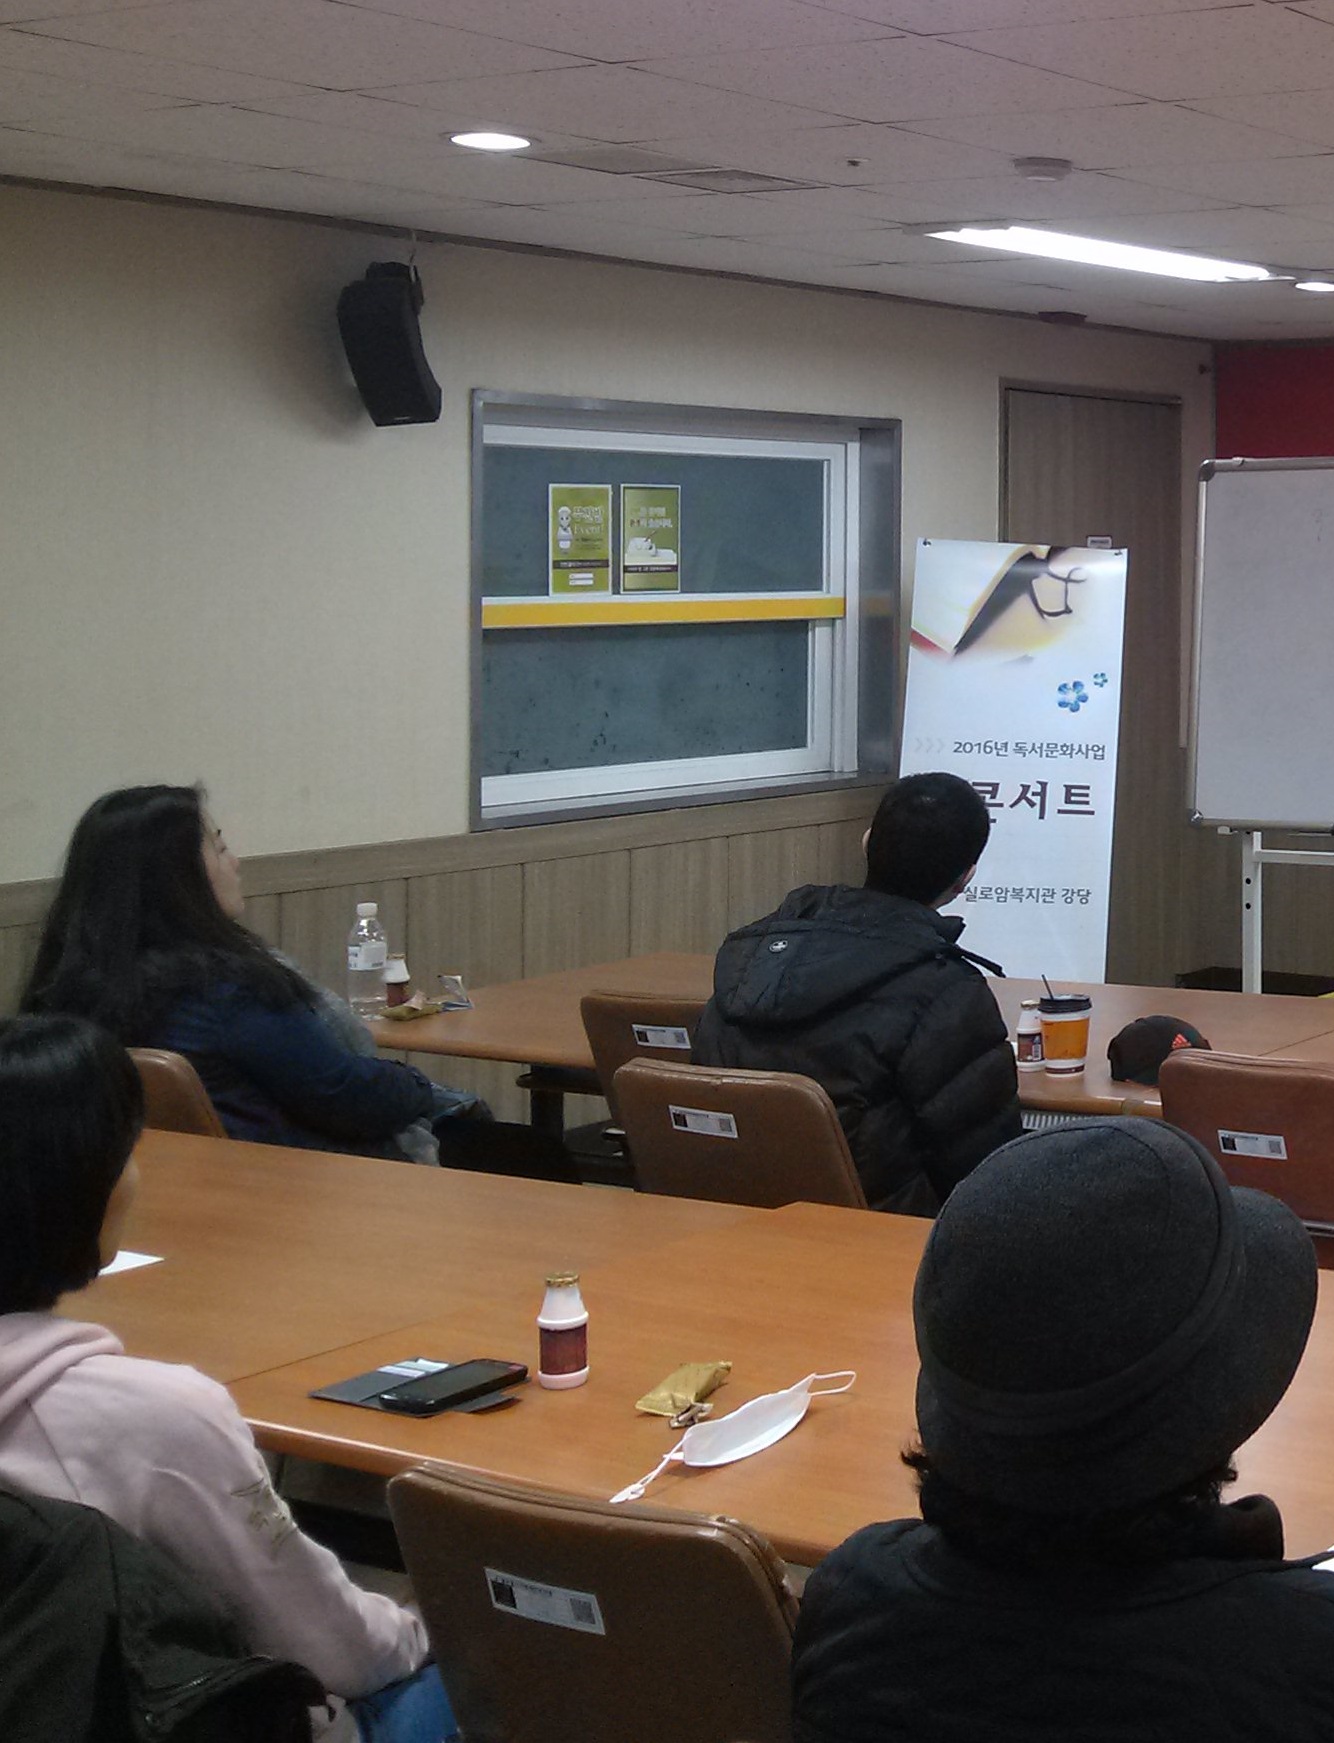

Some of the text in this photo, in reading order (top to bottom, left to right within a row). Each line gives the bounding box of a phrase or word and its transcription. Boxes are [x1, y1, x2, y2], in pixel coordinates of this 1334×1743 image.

[953, 740, 1106, 761] 2016년 독서문화사업
[963, 885, 1092, 905] 실로암복지관 강당
